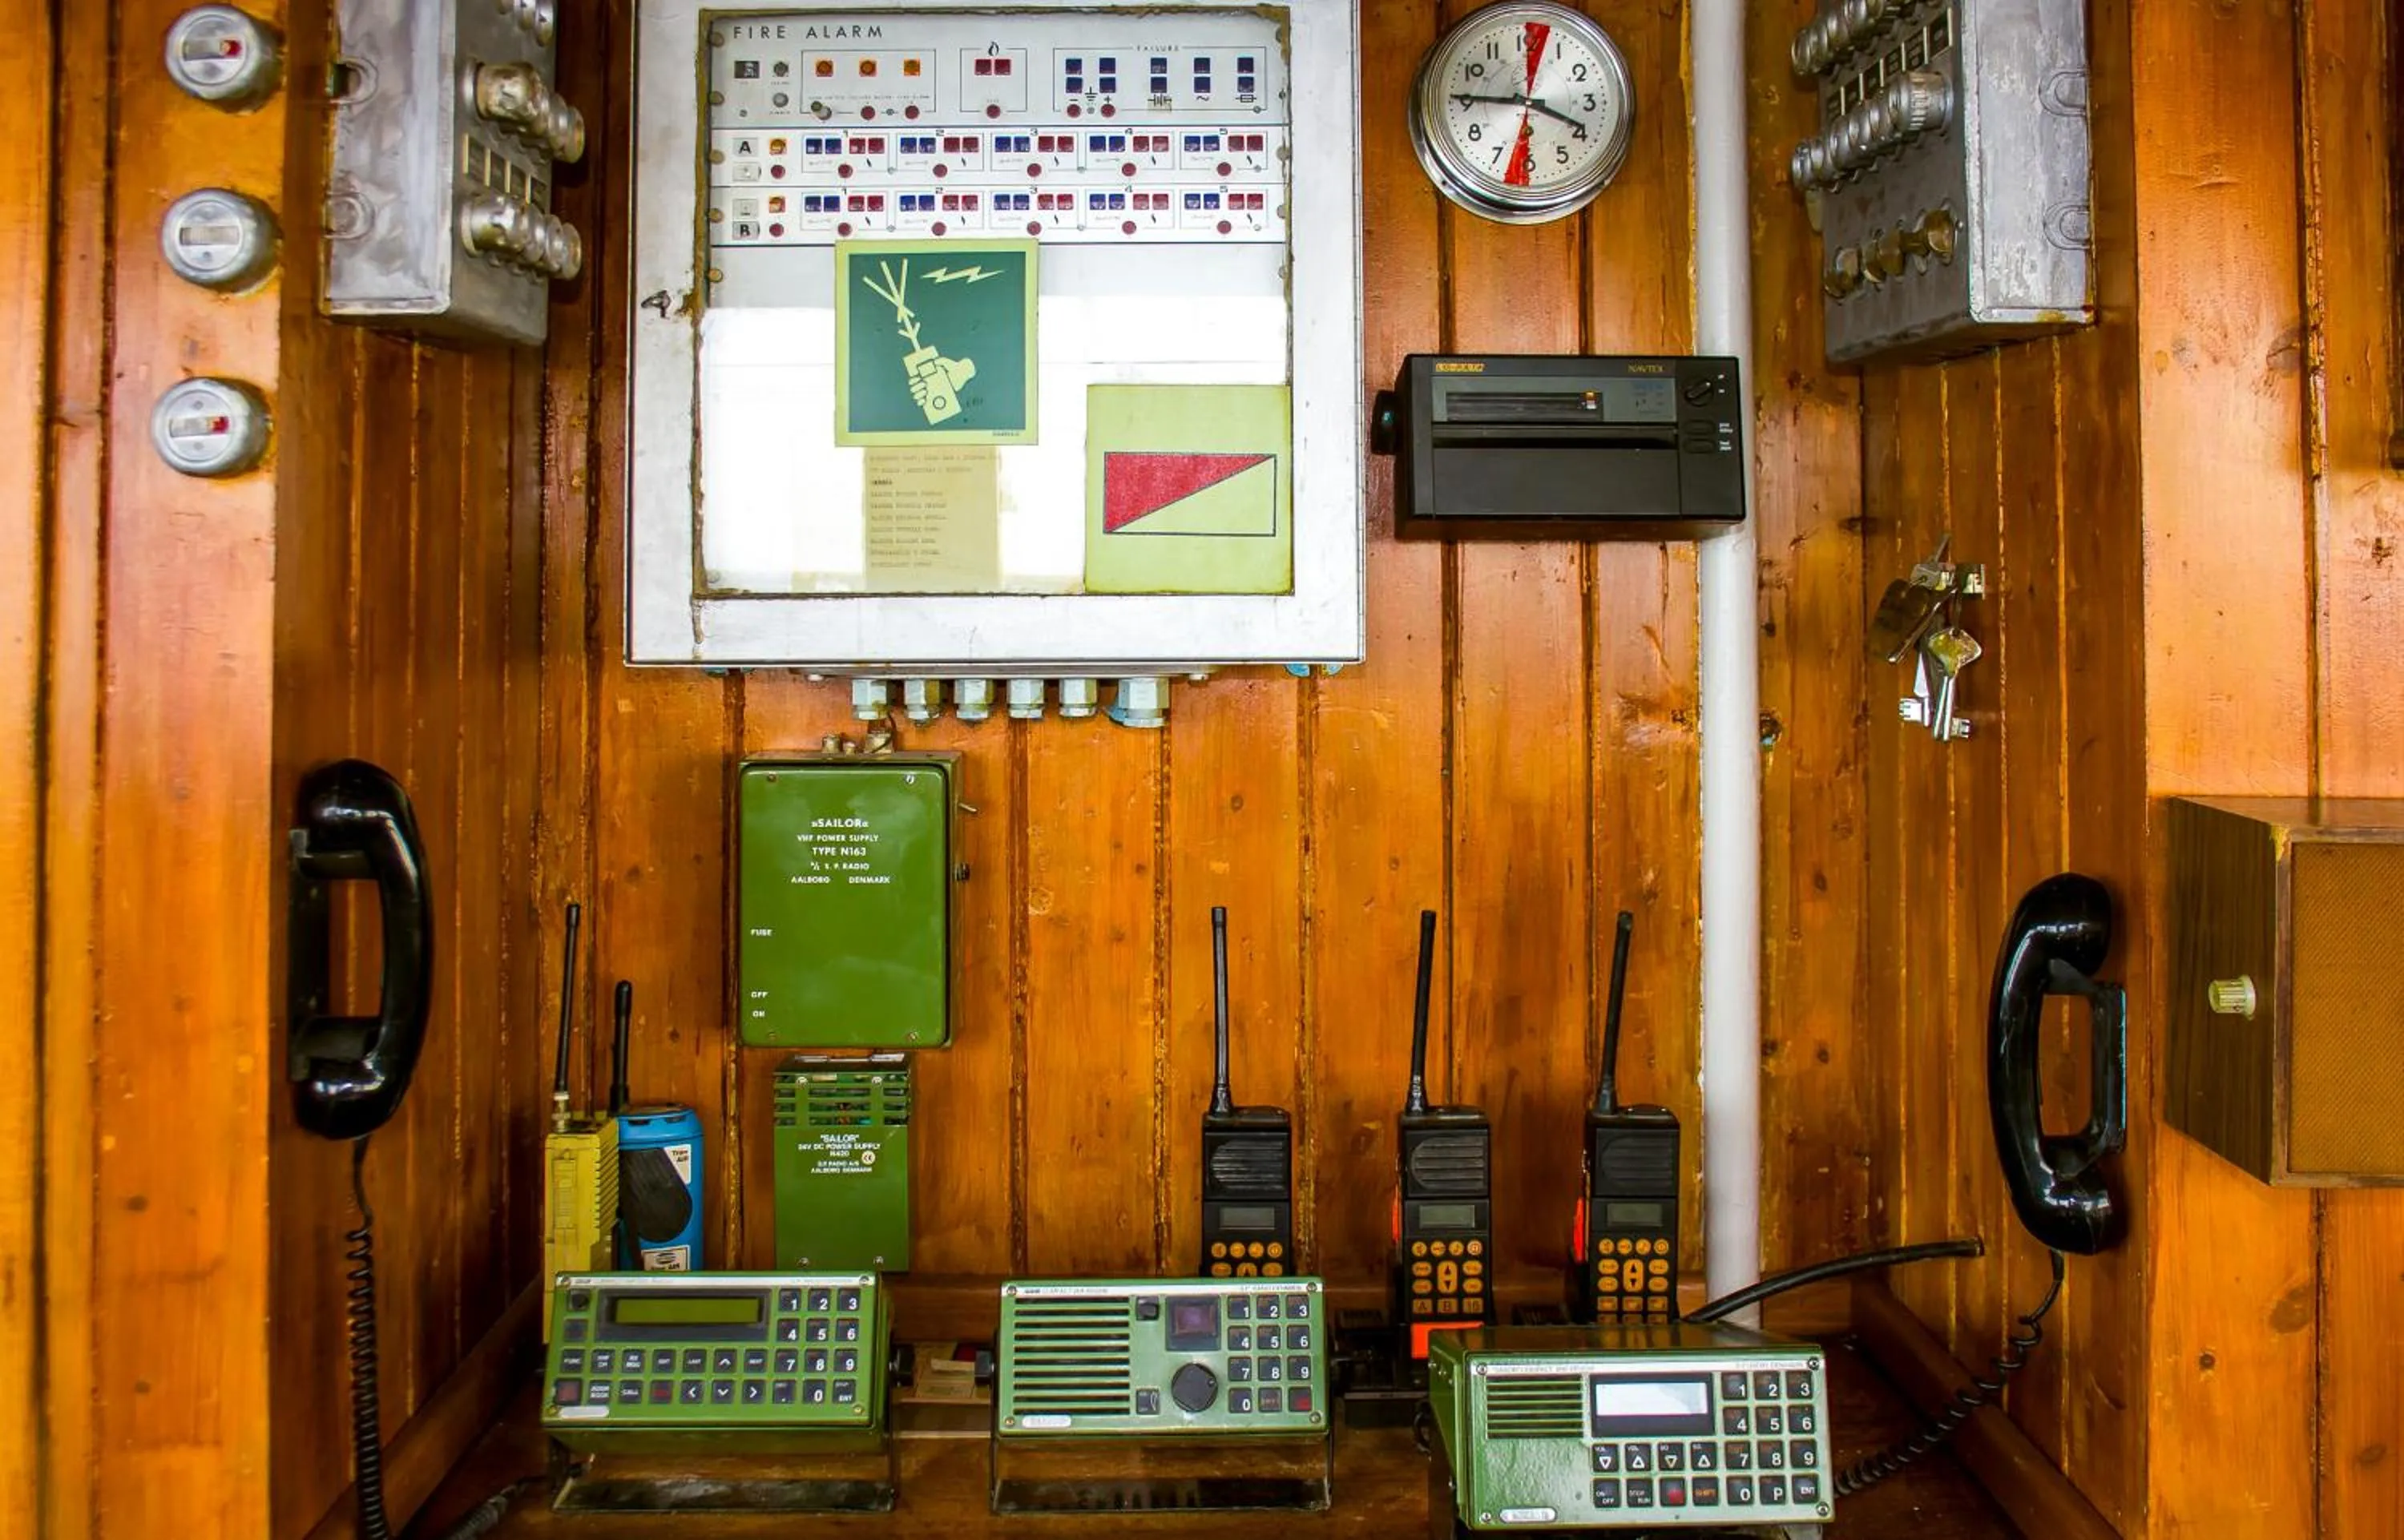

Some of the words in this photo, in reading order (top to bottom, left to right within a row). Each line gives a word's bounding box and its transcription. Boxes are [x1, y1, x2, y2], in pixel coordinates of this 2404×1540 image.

[733, 26, 786, 38] FIRE
[805, 25, 883, 38] ALARM
[1517, 34, 1538, 52] 12
[1486, 42, 1498, 60] 11
[1556, 42, 1561, 59] 1
[1465, 63, 1484, 81] 10
[1572, 64, 1587, 81] 2
[1459, 93, 1474, 111] 9
[1583, 94, 1596, 111] 3
[1468, 123, 1481, 141] 8
[1572, 123, 1587, 142] 4
[739, 141, 752, 153] A
[1492, 147, 1503, 164] 7
[1556, 146, 1568, 163] 5
[1523, 154, 1535, 172] 6
[740, 225, 750, 236] B
[813, 847, 837, 856] TYPE
[841, 847, 866, 856] N163
[791, 1299, 797, 1310] 1
[820, 1298, 828, 1310] 2
[849, 1298, 857, 1309] 3
[1244, 1307, 1248, 1317] 1
[1270, 1305, 1278, 1317] 2
[1299, 1305, 1307, 1316] 3
[788, 1329, 797, 1340] 4
[818, 1328, 826, 1340] 5
[847, 1328, 855, 1340] 6
[1241, 1336, 1248, 1348] 4
[1271, 1336, 1279, 1348] 5
[1301, 1336, 1309, 1347] 6
[787, 1359, 795, 1371] 7
[816, 1359, 825, 1371] 8
[845, 1359, 854, 1371] 9
[1241, 1368, 1249, 1379] 7
[1272, 1367, 1279, 1379] 8
[1301, 1367, 1309, 1378] 9
[814, 1389, 822, 1401] 0
[1740, 1385, 1745, 1397] 1
[1769, 1384, 1777, 1397] 2
[1801, 1383, 1809, 1396] 3
[1242, 1399, 1250, 1410] 0
[1737, 1418, 1746, 1431] 4
[1770, 1417, 1780, 1430] 5
[1803, 1417, 1812, 1430] 6
[1740, 1453, 1749, 1466] 7
[1772, 1453, 1781, 1465] 8
[1805, 1452, 1813, 1465] 9
[1740, 1488, 1750, 1501] 0
[1773, 1487, 1783, 1501] P
[1801, 1486, 1814, 1494] ENT
